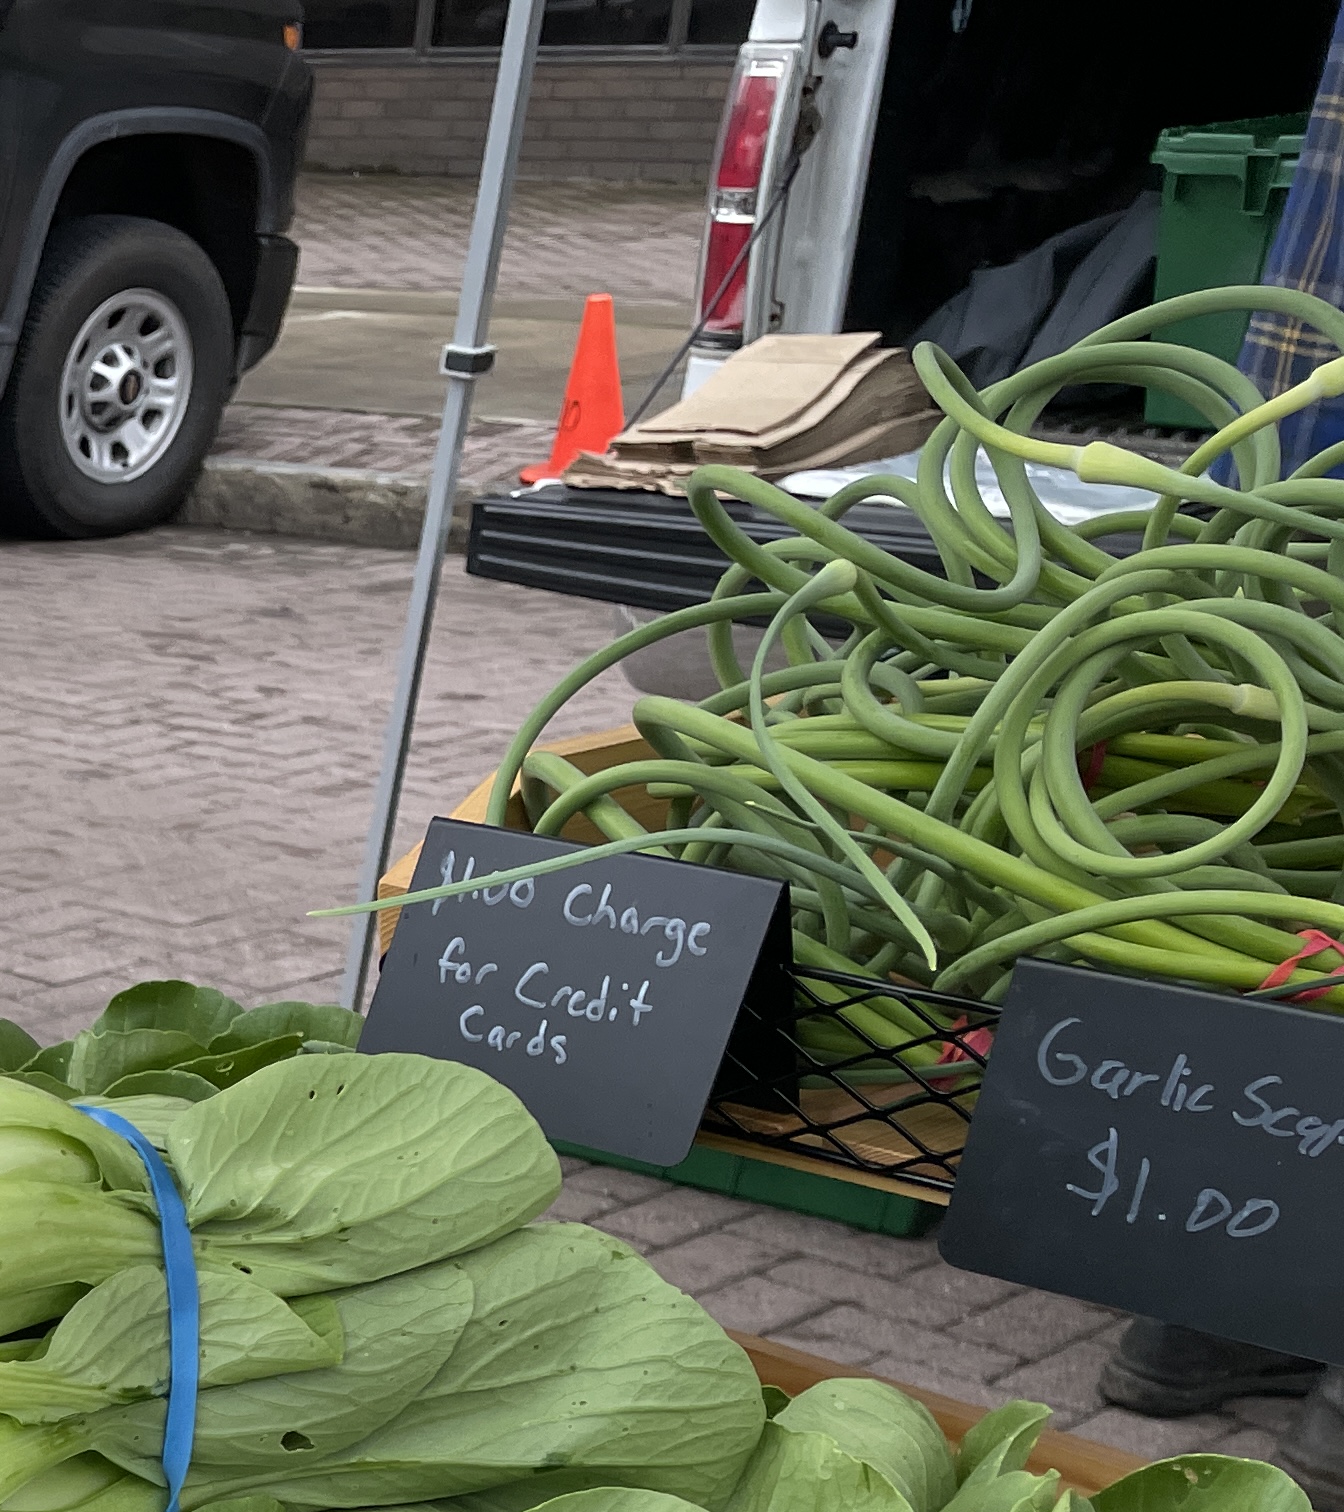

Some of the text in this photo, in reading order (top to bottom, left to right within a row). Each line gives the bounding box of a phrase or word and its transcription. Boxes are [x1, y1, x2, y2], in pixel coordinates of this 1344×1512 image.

[563, 883, 712, 967] Charge
[438, 936, 654, 1027] for Credit
[459, 1004, 568, 1065] Cards
[1037, 1016, 1215, 1113] Garlic
[1065, 1126, 1281, 1238] $1.00
